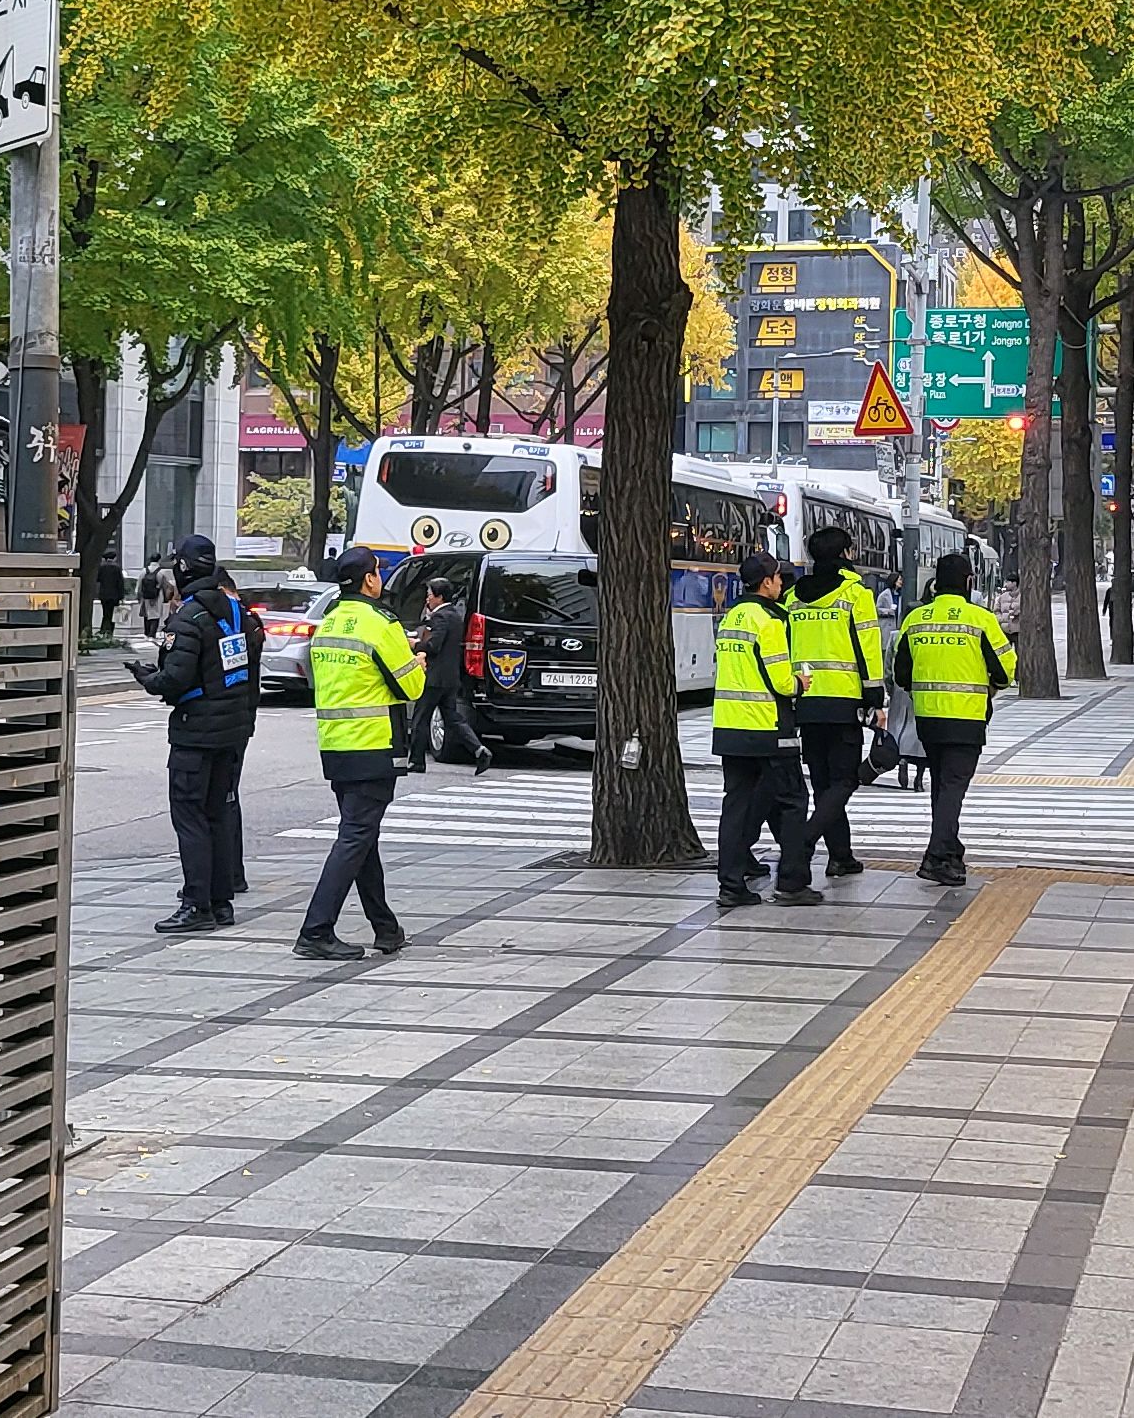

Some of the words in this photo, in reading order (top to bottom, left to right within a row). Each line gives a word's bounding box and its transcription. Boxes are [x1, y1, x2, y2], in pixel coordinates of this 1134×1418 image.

[766, 266, 793, 282] 정형
[766, 320, 793, 335] 도수
[929, 313, 987, 329] 종로구청
[991, 318, 1023, 330] Jongno
[932, 330, 986, 346] 종로1가
[991, 336, 1023, 347] Jongno
[895, 372, 947, 388] 청광장
[792, 611, 839, 622] POLICE
[913, 636, 966, 646] POLICE
[569, 674, 593, 685] 1228
